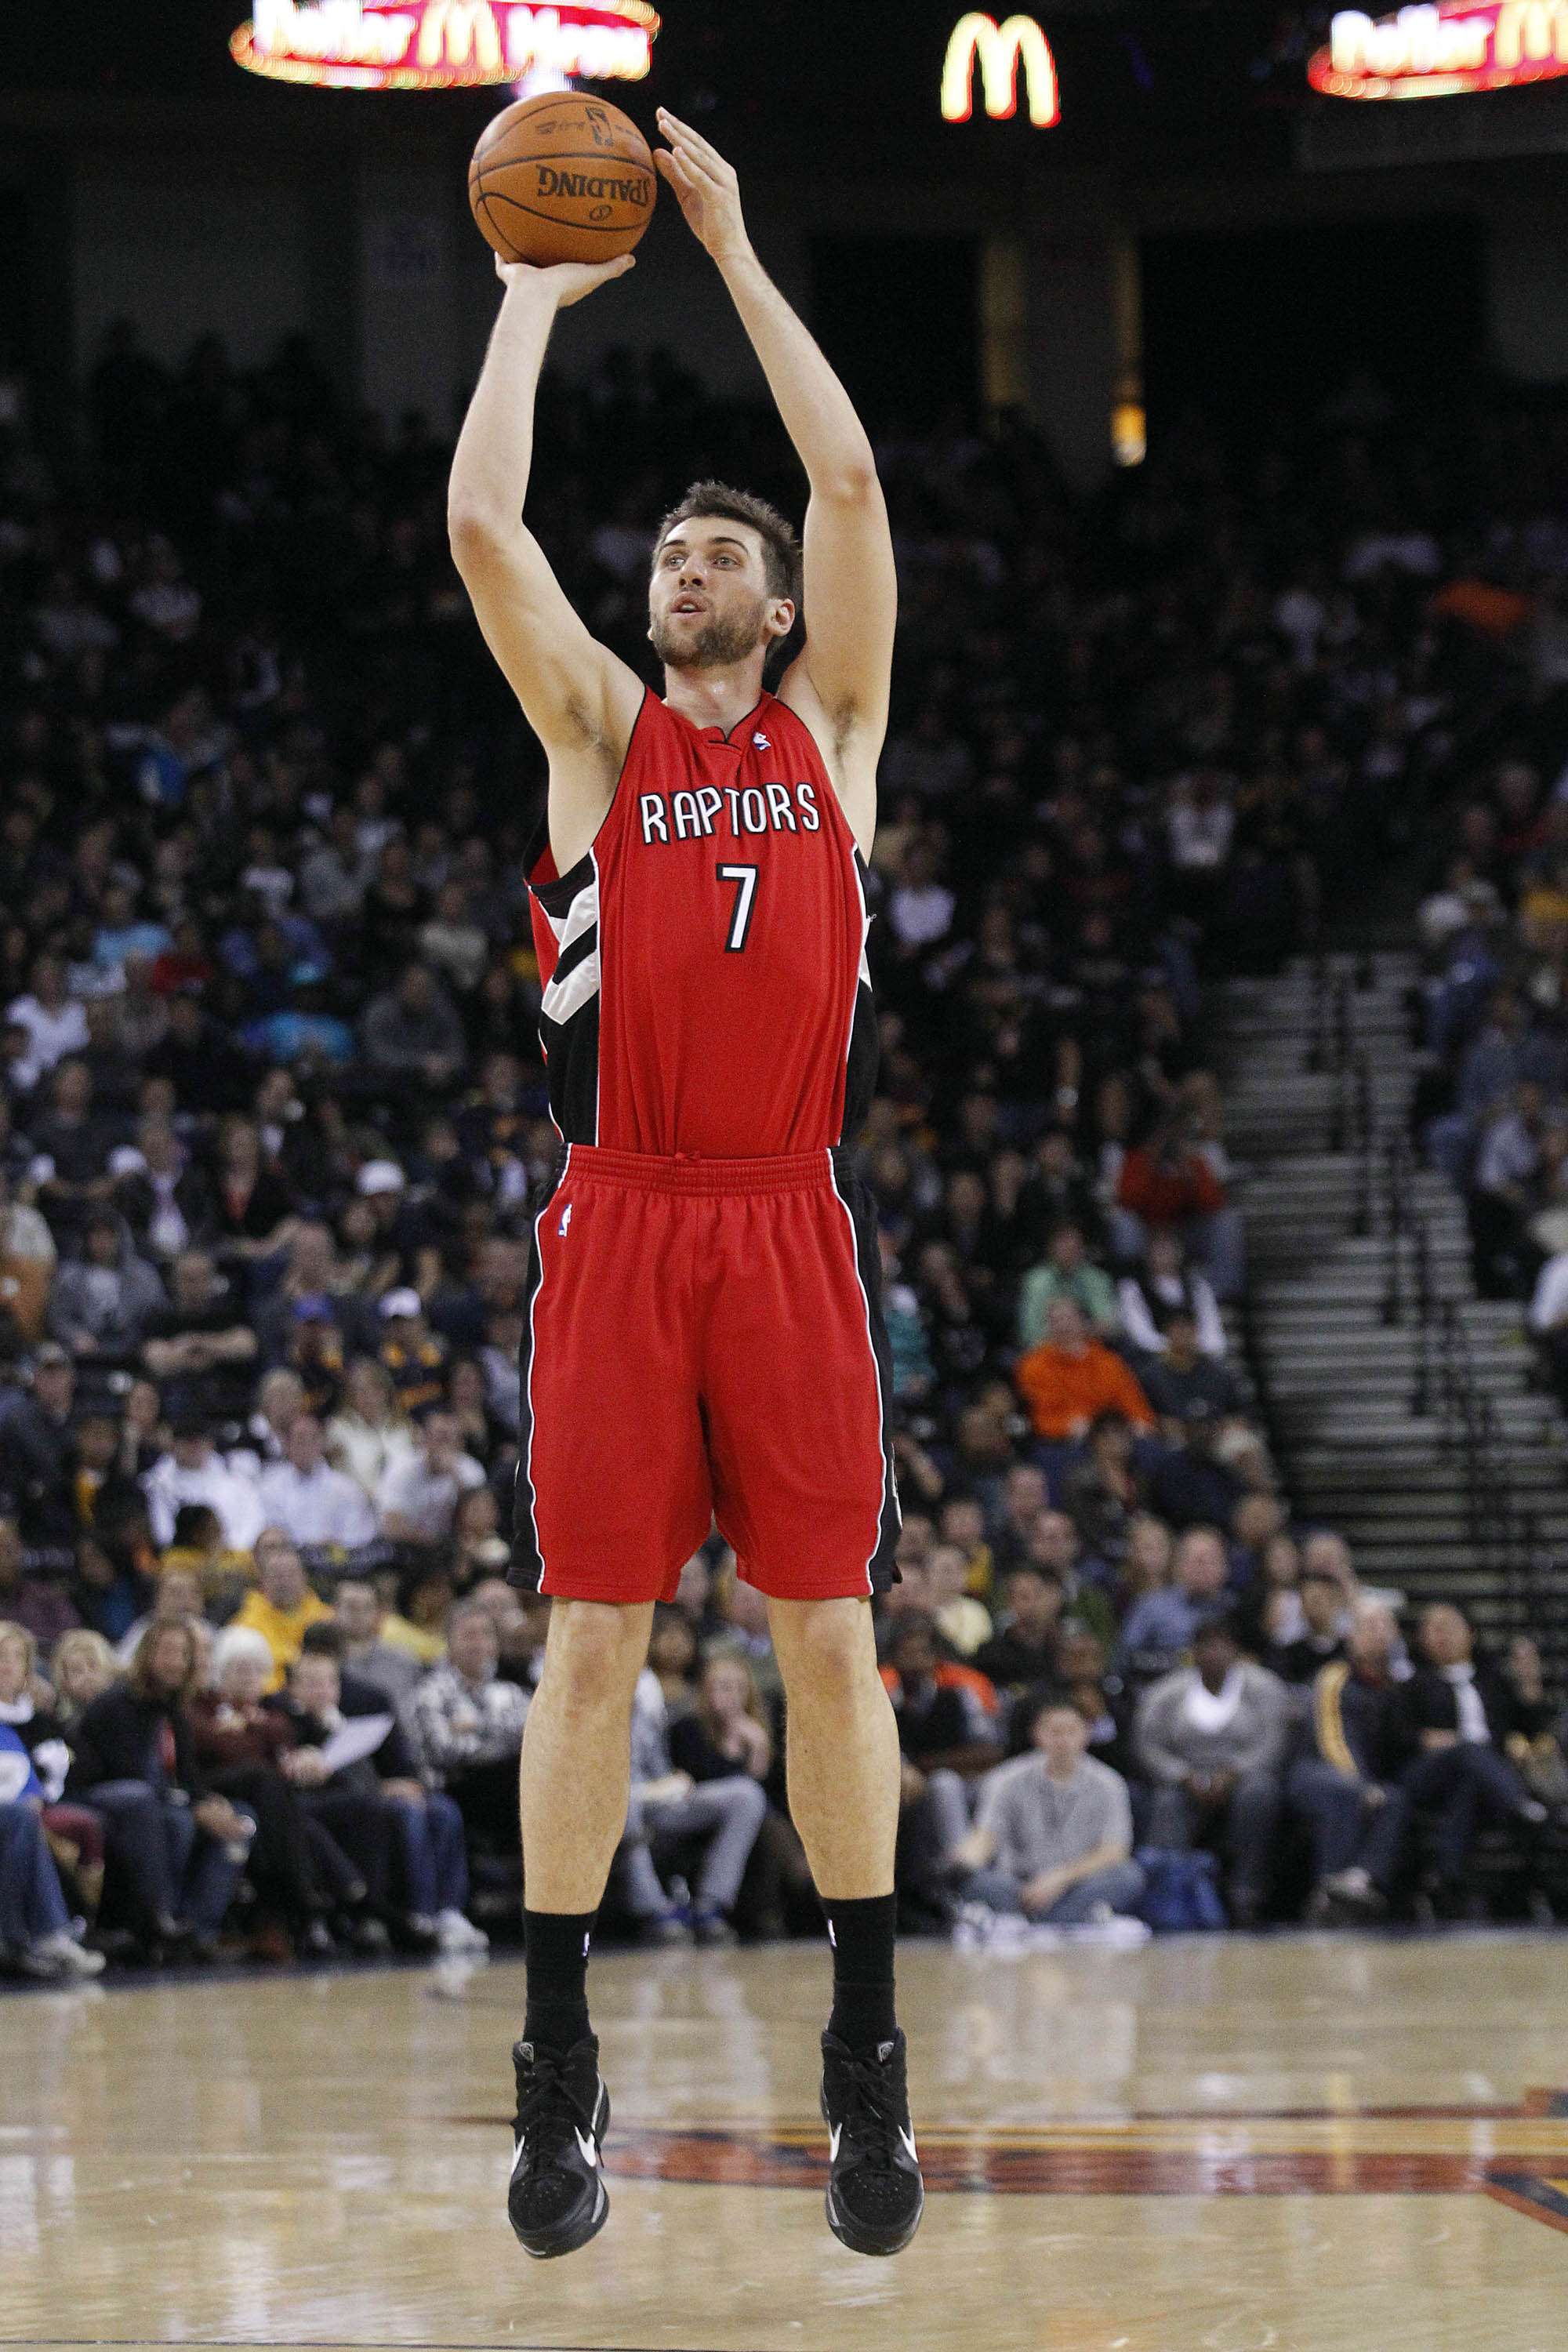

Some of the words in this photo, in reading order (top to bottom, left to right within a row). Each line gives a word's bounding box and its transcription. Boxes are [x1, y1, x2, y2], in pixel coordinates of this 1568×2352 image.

[535, 164, 650, 206] SPALDING
[639, 782, 820, 845] RAPTORS
[716, 863, 760, 954] 7
